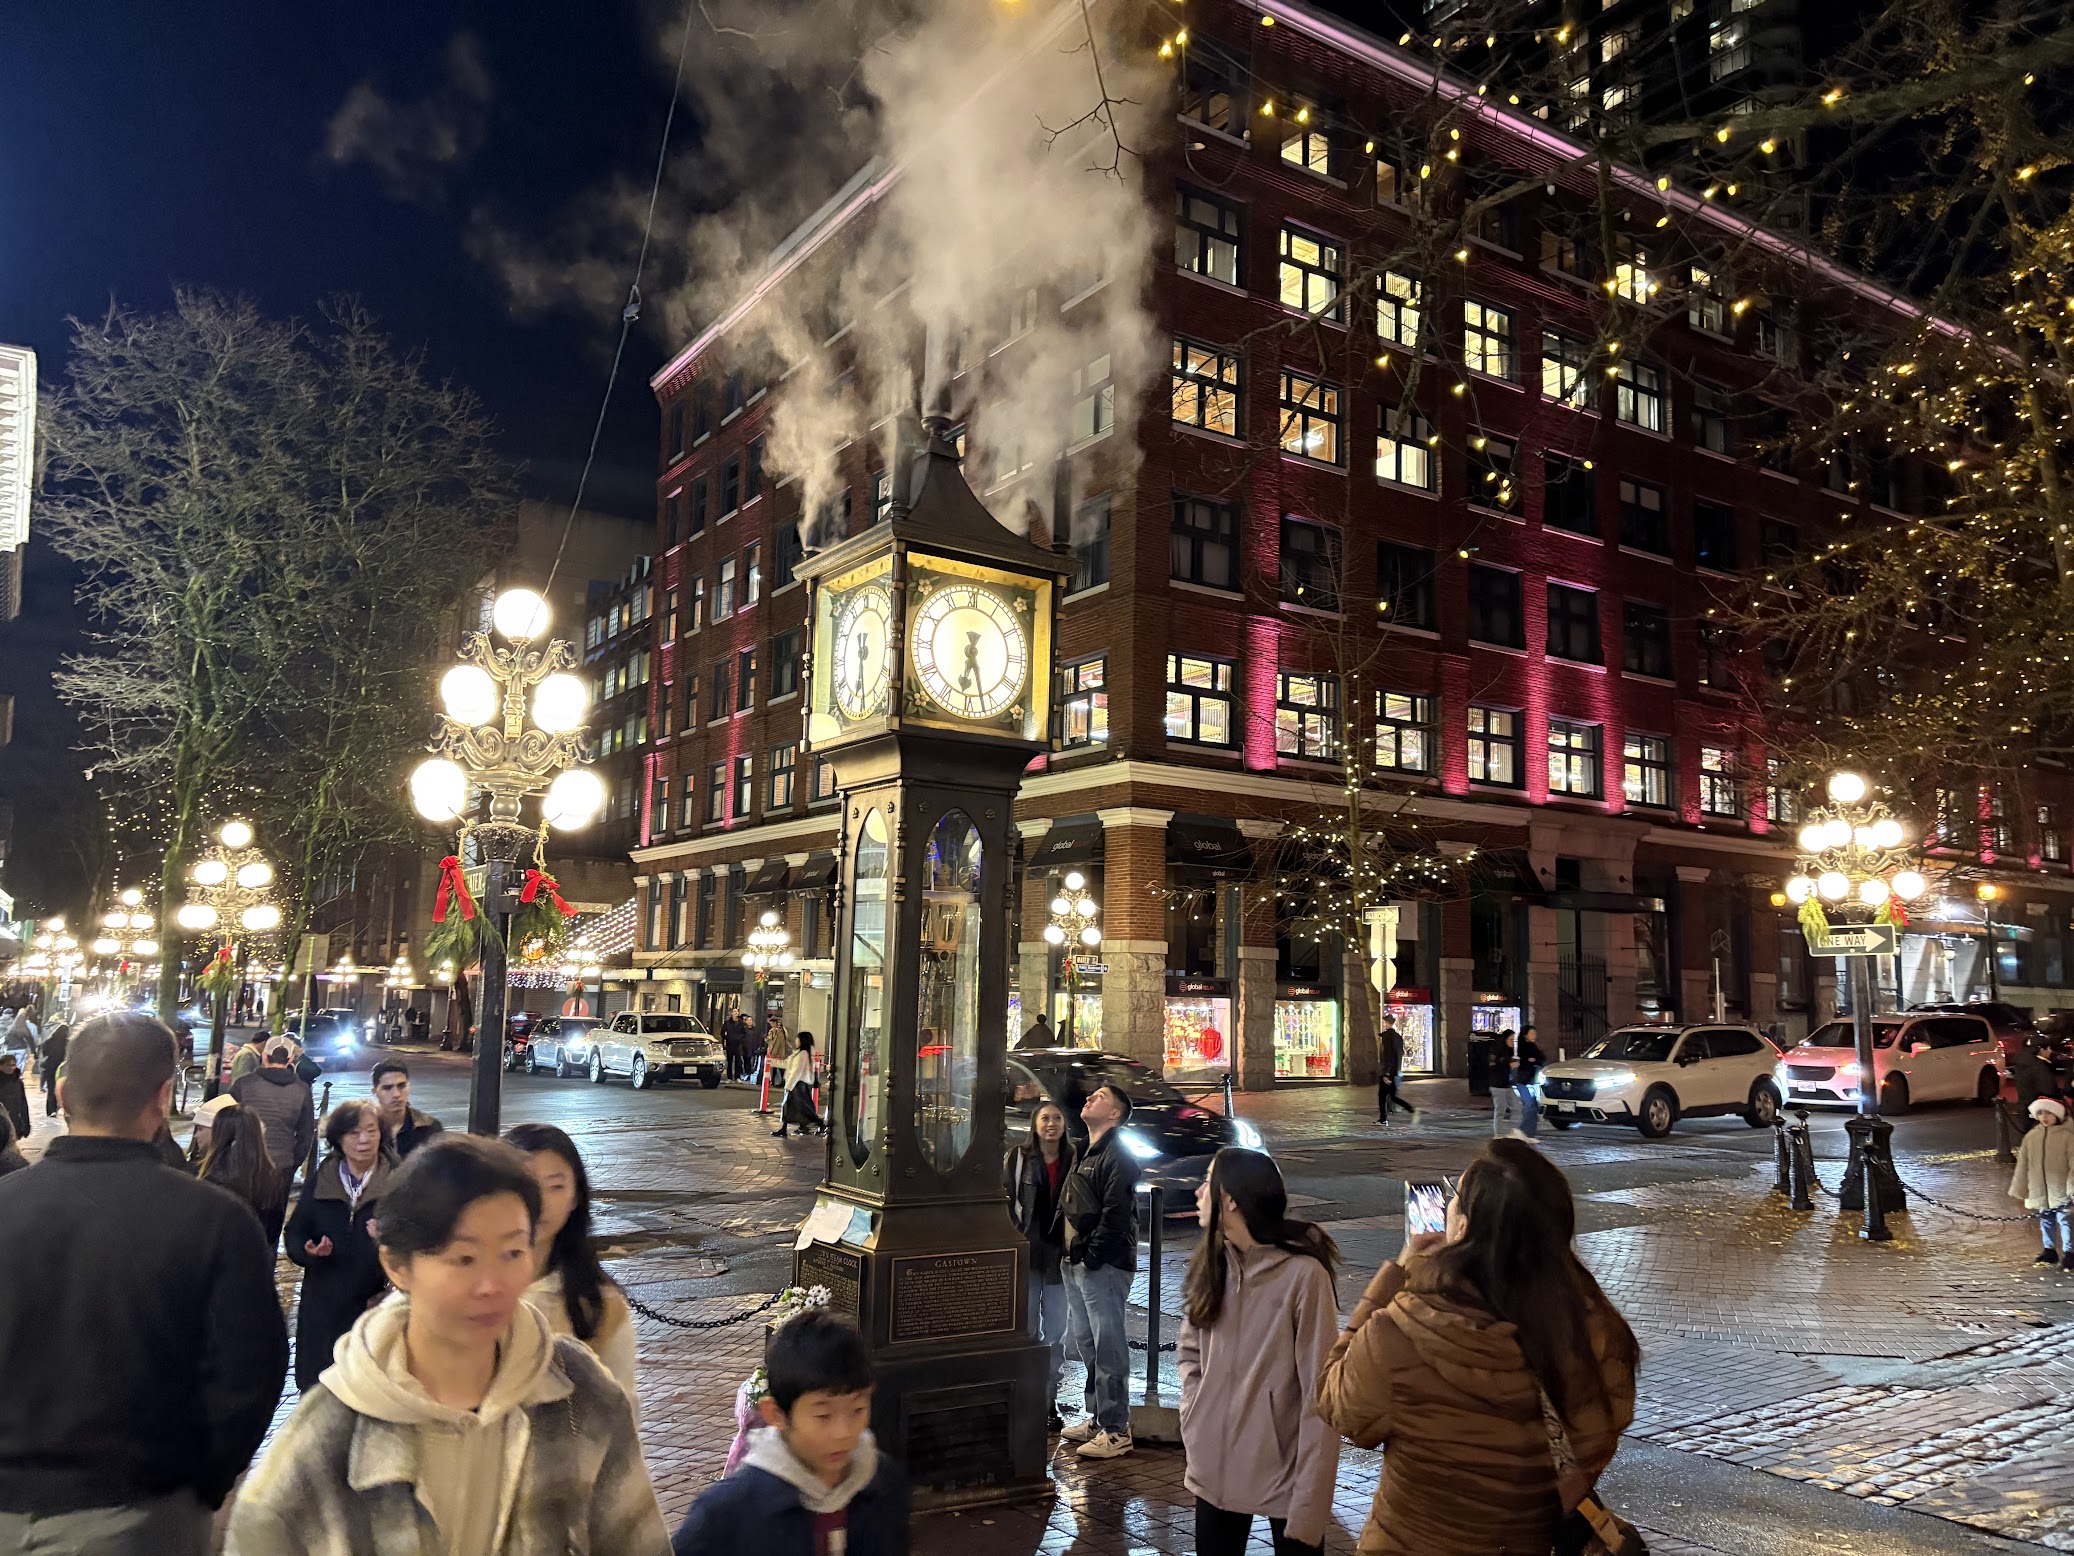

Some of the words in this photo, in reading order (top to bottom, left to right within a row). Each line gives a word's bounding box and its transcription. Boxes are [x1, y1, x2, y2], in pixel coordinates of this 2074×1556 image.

[1051, 840, 1075, 853] global
[1194, 840, 1222, 851] global
[1844, 935, 1867, 946] WAY
[1187, 983, 1203, 991] global
[1295, 987, 1310, 996] global
[1395, 990, 1409, 998] global
[1486, 994, 1499, 1002] global
[935, 1258, 978, 1268] GASTOWN
